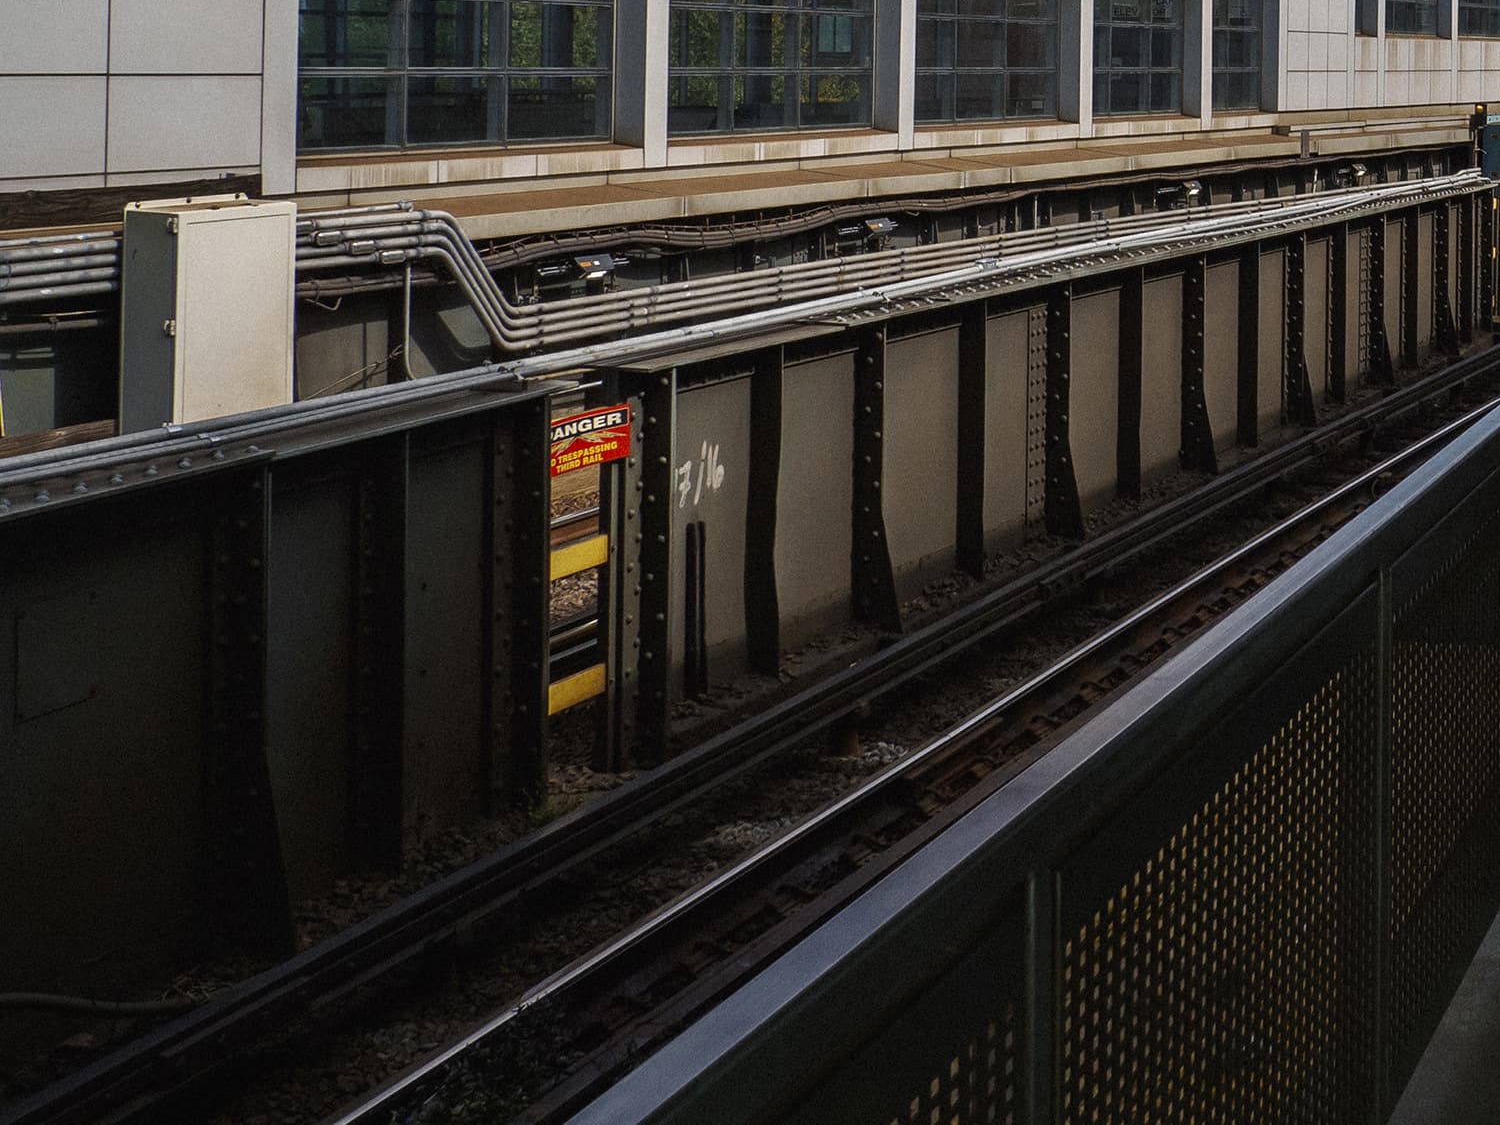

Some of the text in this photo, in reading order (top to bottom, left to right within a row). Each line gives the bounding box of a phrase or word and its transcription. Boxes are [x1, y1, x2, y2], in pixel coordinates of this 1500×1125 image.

[551, 412, 622, 442] ANGER
[557, 453, 604, 474] THIRD RAIL
[558, 441, 618, 464] TRESPASSING
